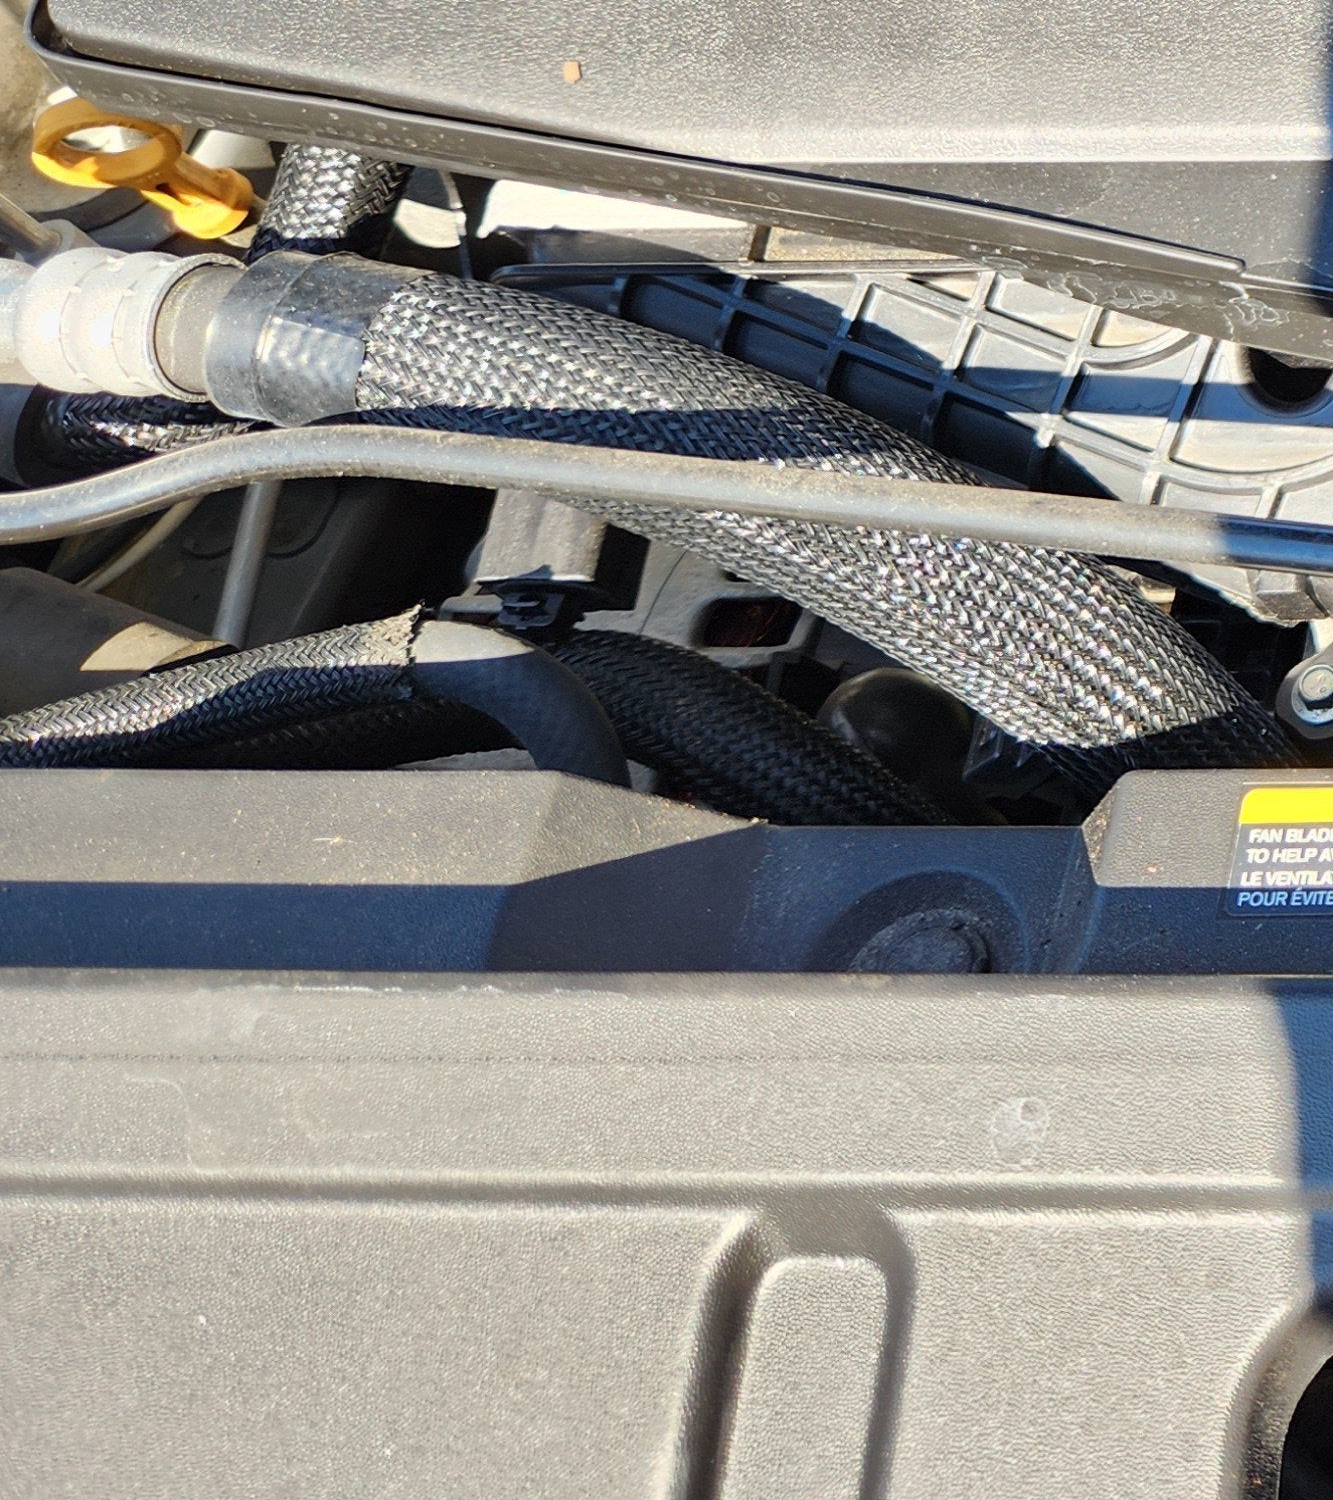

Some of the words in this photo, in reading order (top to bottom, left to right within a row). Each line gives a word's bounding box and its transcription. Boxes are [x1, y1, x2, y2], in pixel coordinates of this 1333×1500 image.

[1249, 827, 1284, 844] FAN
[1246, 847, 1270, 864] TO
[1271, 846, 1318, 863] HELP
[1240, 869, 1263, 887] LE
[1237, 890, 1288, 907] POUR
